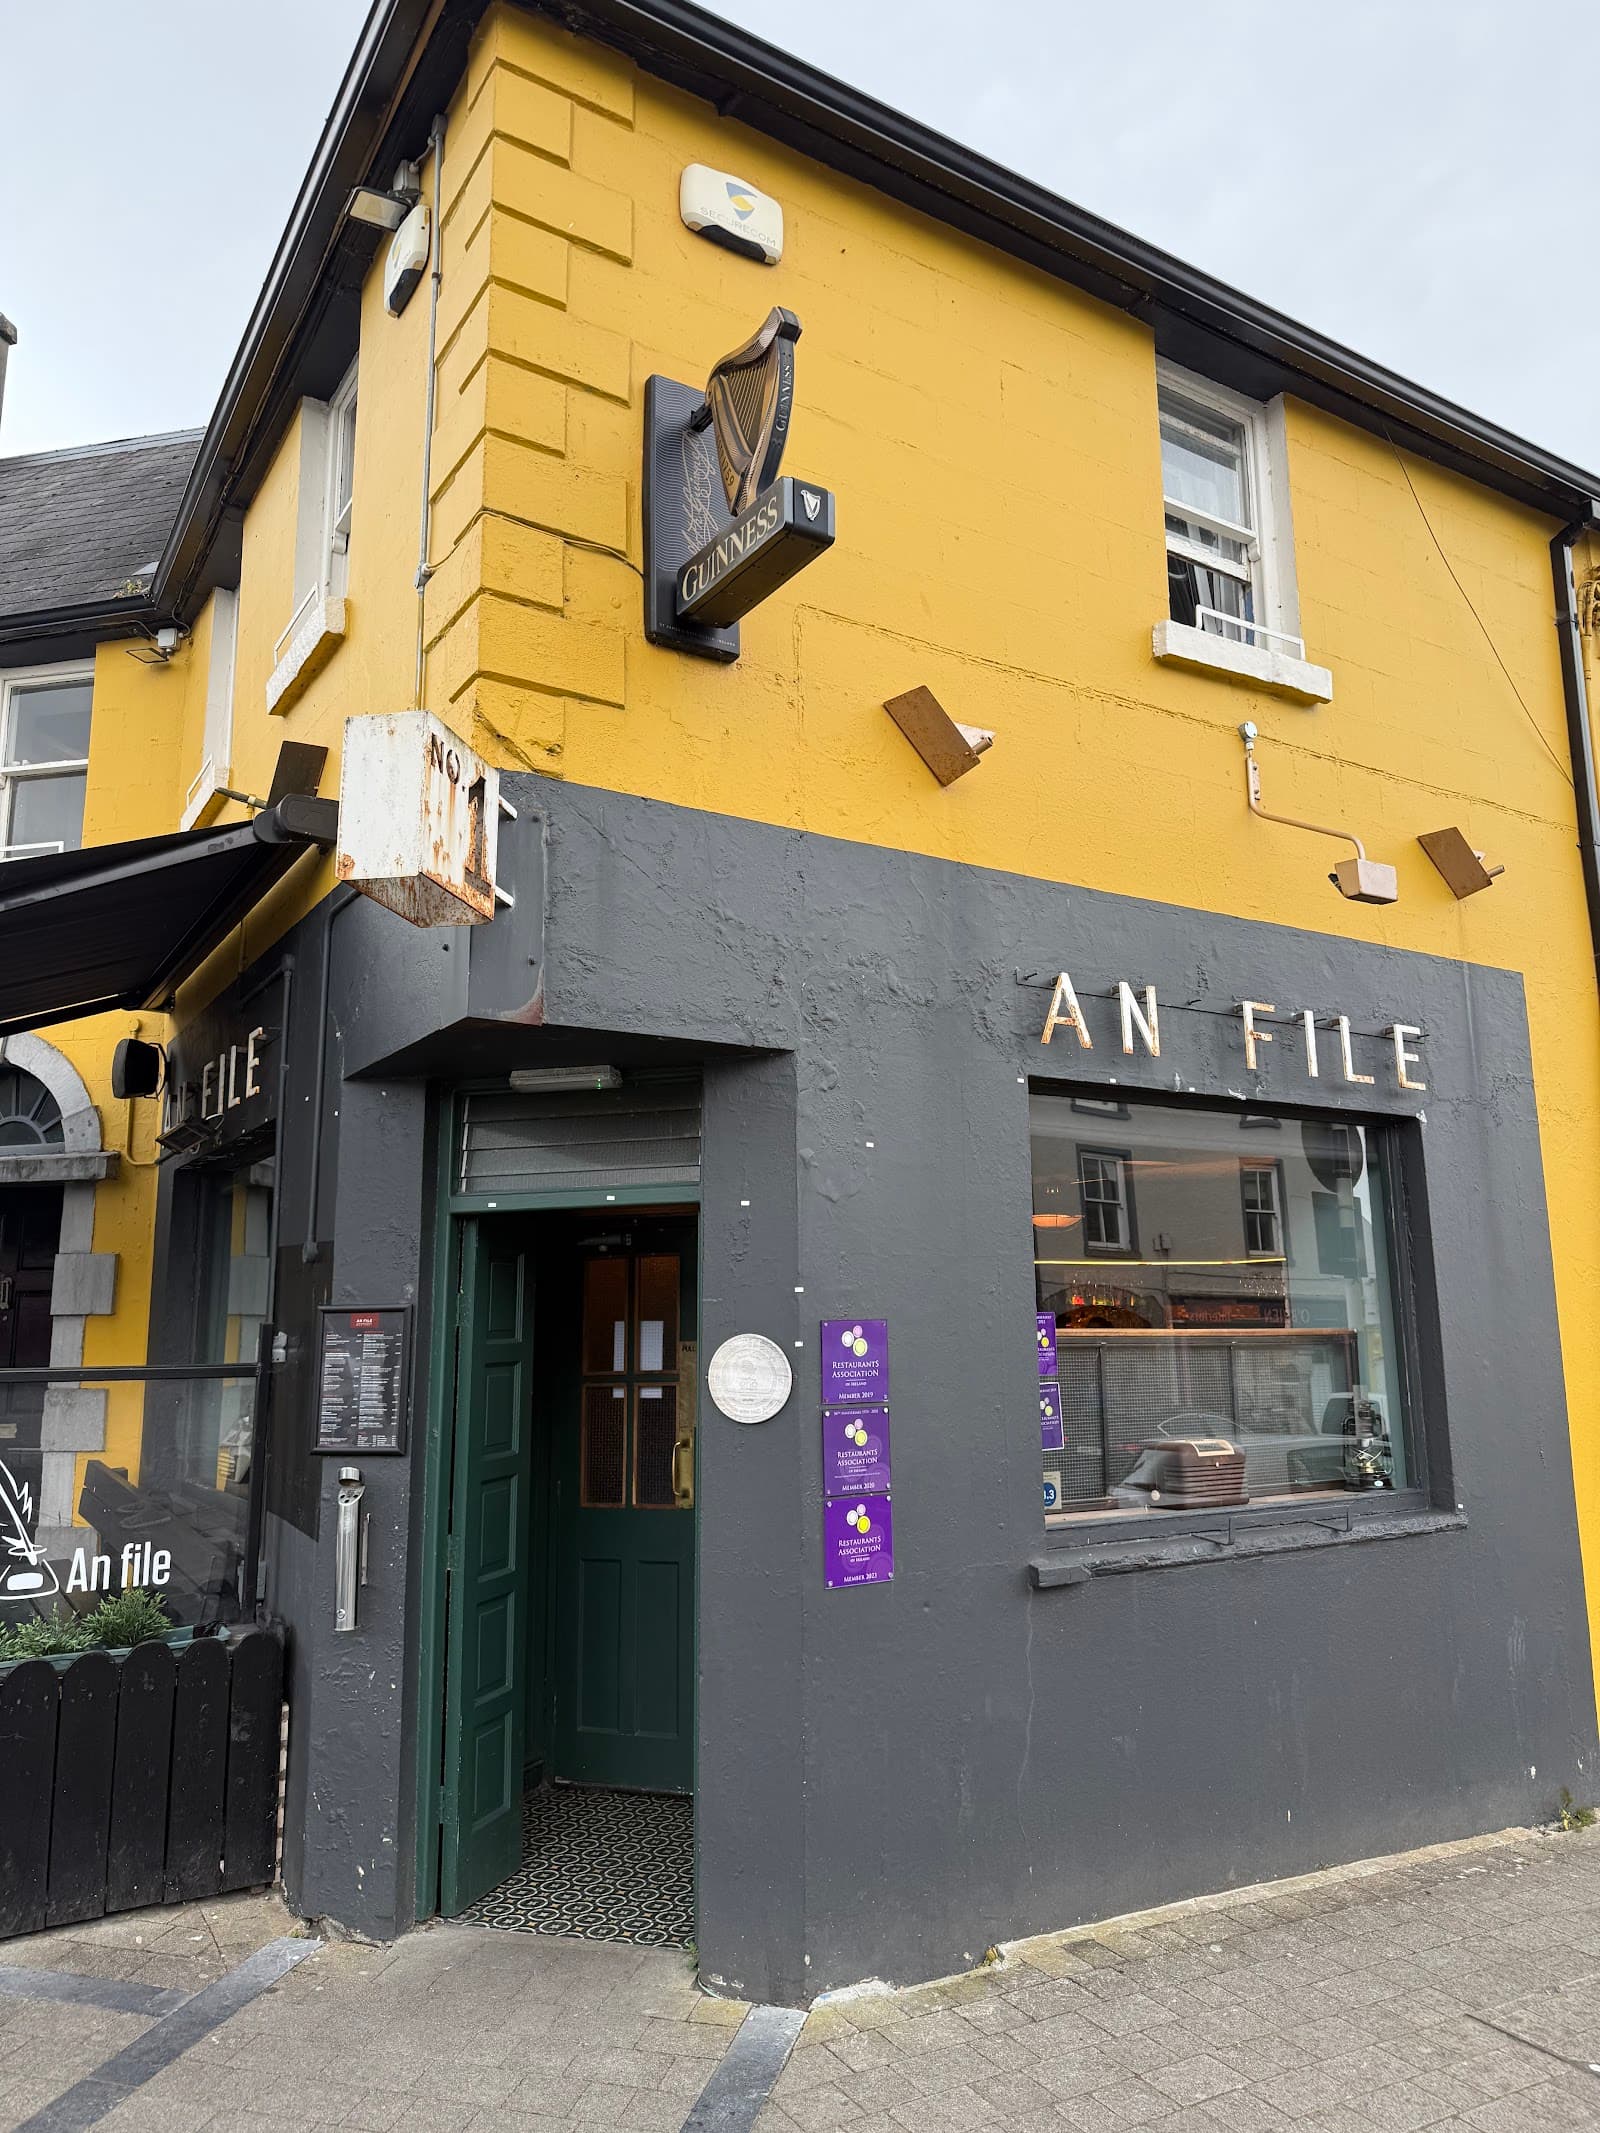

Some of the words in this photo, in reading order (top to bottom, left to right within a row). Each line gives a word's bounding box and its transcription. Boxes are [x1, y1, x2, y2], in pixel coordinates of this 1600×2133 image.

[699, 206, 777, 248] SECURECOM
[775, 364, 793, 432] GUINNESS
[682, 496, 779, 602] GUINNESS
[1040, 971, 1160, 1057] AN
[1242, 1000, 1427, 1090] FILE
[201, 1026, 264, 1120] FILE
[832, 1360, 880, 1369] RESTAURANTS
[832, 1369, 879, 1378] ASSOCIATION
[838, 1392, 861, 1400] MEMBER
[861, 1391, 874, 1399] 2019
[837, 1449, 878, 1459] RESTAURANTS
[837, 1457, 878, 1467] ASSOCIATION
[842, 1484, 863, 1492] MEMBER
[838, 1536, 881, 1547] RESTAURANTS
[838, 1544, 881, 1556] ASSOCIATION
[65, 1547, 111, 1594] An
[120, 1541, 172, 1589] file
[843, 1574, 865, 1583] MEMBER
